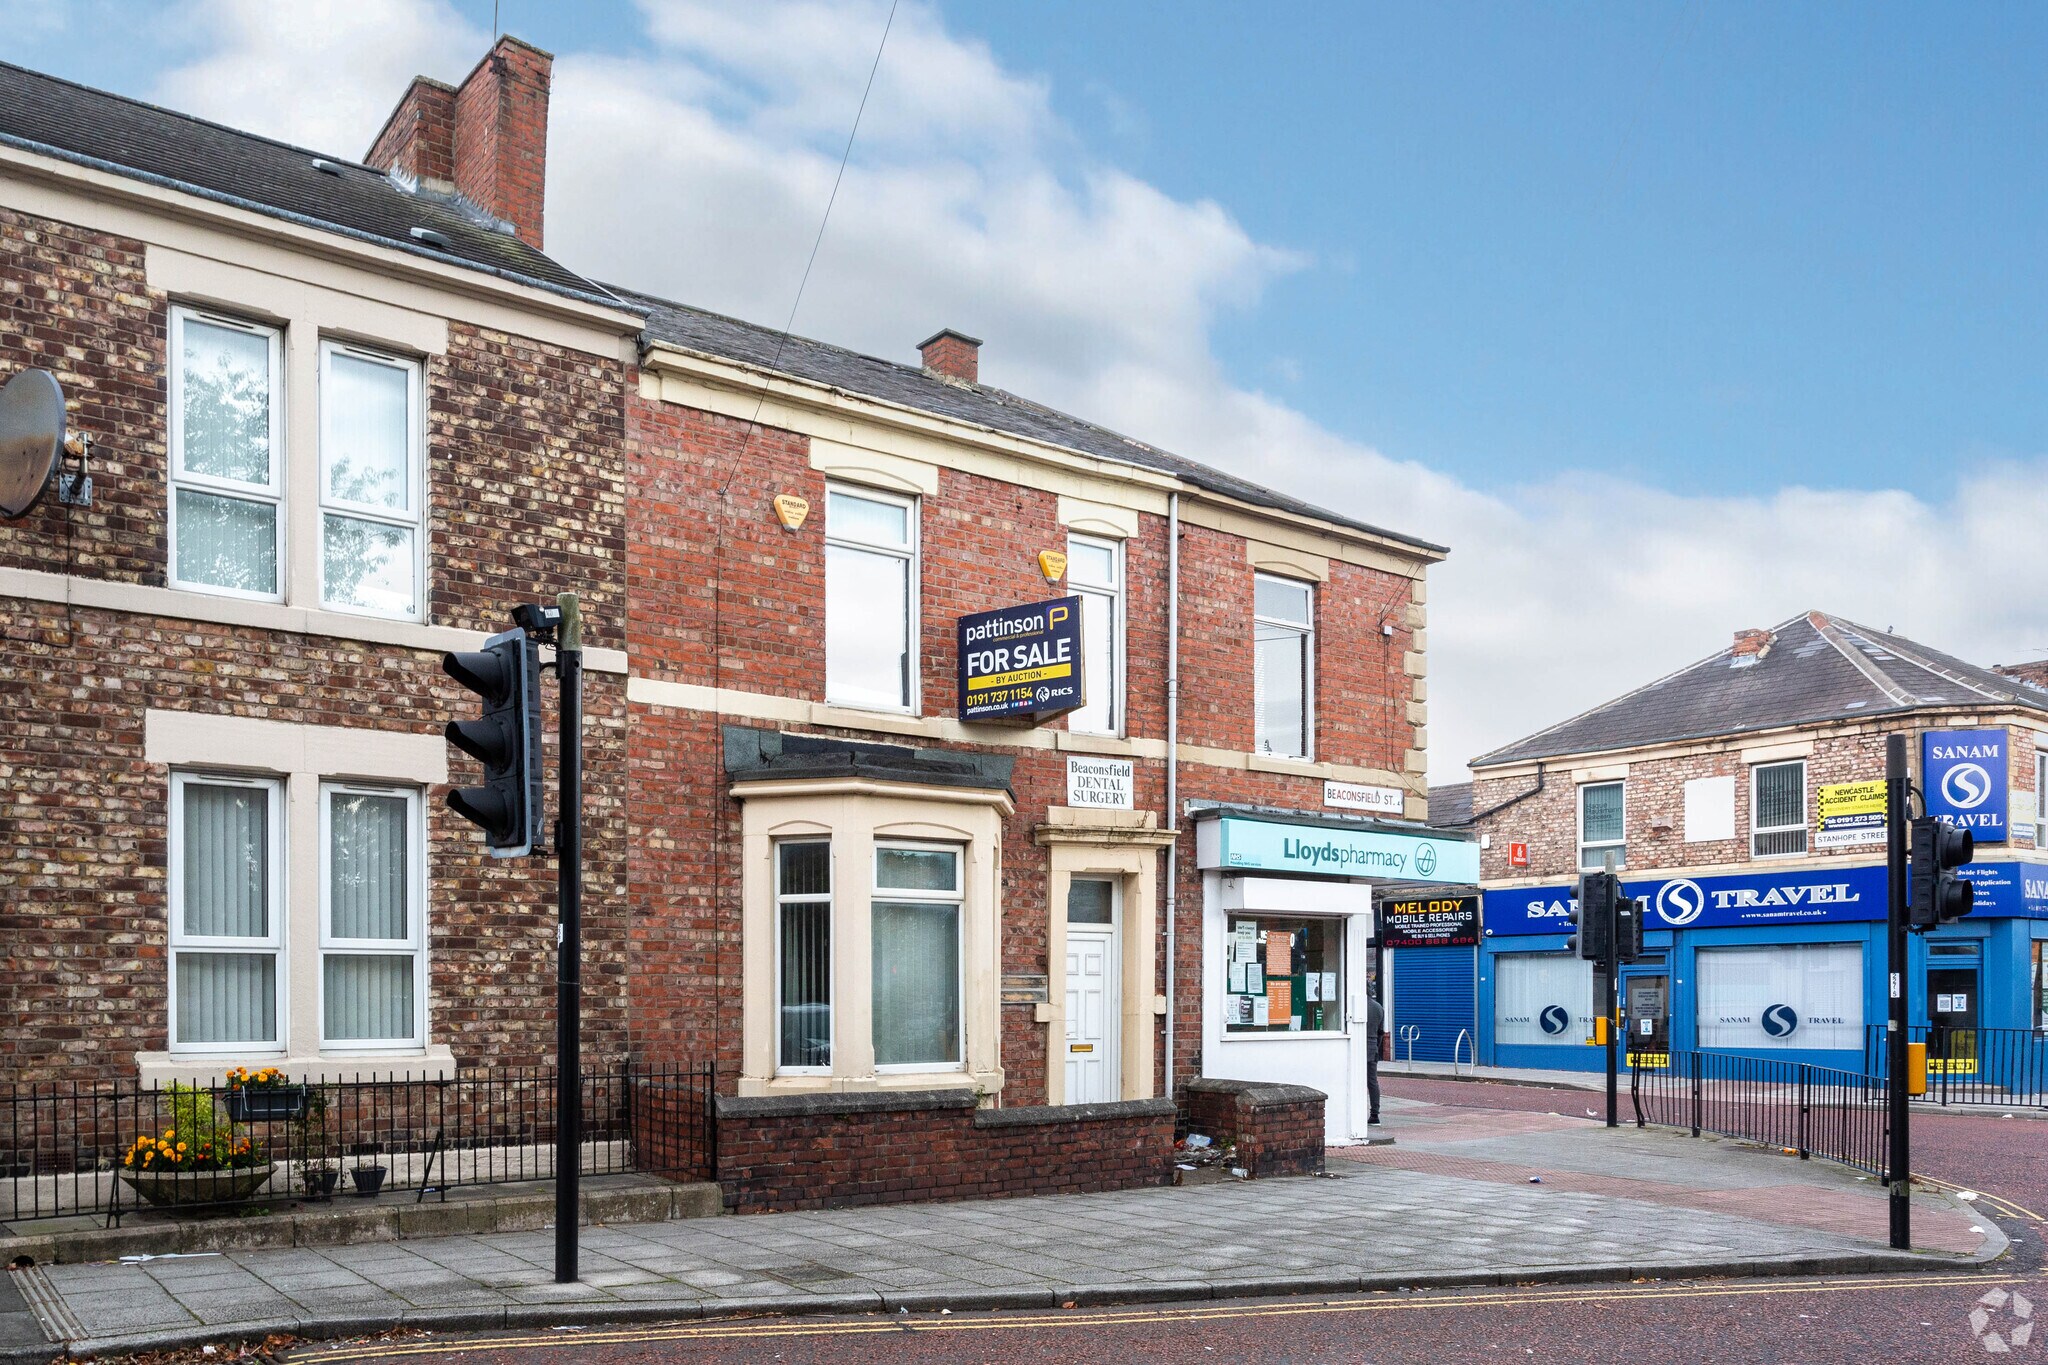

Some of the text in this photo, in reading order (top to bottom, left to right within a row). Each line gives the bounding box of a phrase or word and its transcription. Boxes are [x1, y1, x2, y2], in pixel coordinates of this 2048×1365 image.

[966, 614, 1044, 645] pattinson
[967, 637, 1071, 676] FOR SALE
[996, 671, 1042, 684] BY AUCTION
[966, 686, 1033, 706] 0191 737 1154
[1051, 687, 1073, 697] RICS
[966, 702, 1009, 715] pattinson.co.uk
[1933, 744, 1999, 759] SANAM
[1071, 761, 1130, 777] Beaconsfield
[1077, 776, 1124, 791] DENTAL
[1073, 790, 1126, 804] SURGERY
[1327, 788, 1380, 804] BEACONSFIELD
[1835, 786, 1874, 796] NEWCASTLE
[1825, 793, 1885, 805] ACCIDENT CLAIMS
[1818, 831, 1887, 843] STANHOPE STREE
[1283, 838, 1407, 873] Lloydspharmacy
[1711, 883, 1860, 909] TRAVEL
[1394, 900, 1463, 914] MELODY
[1745, 909, 1822, 918] www.sanamtravel.co.uk
[1386, 911, 1472, 923] MOBILE REPAIRS
